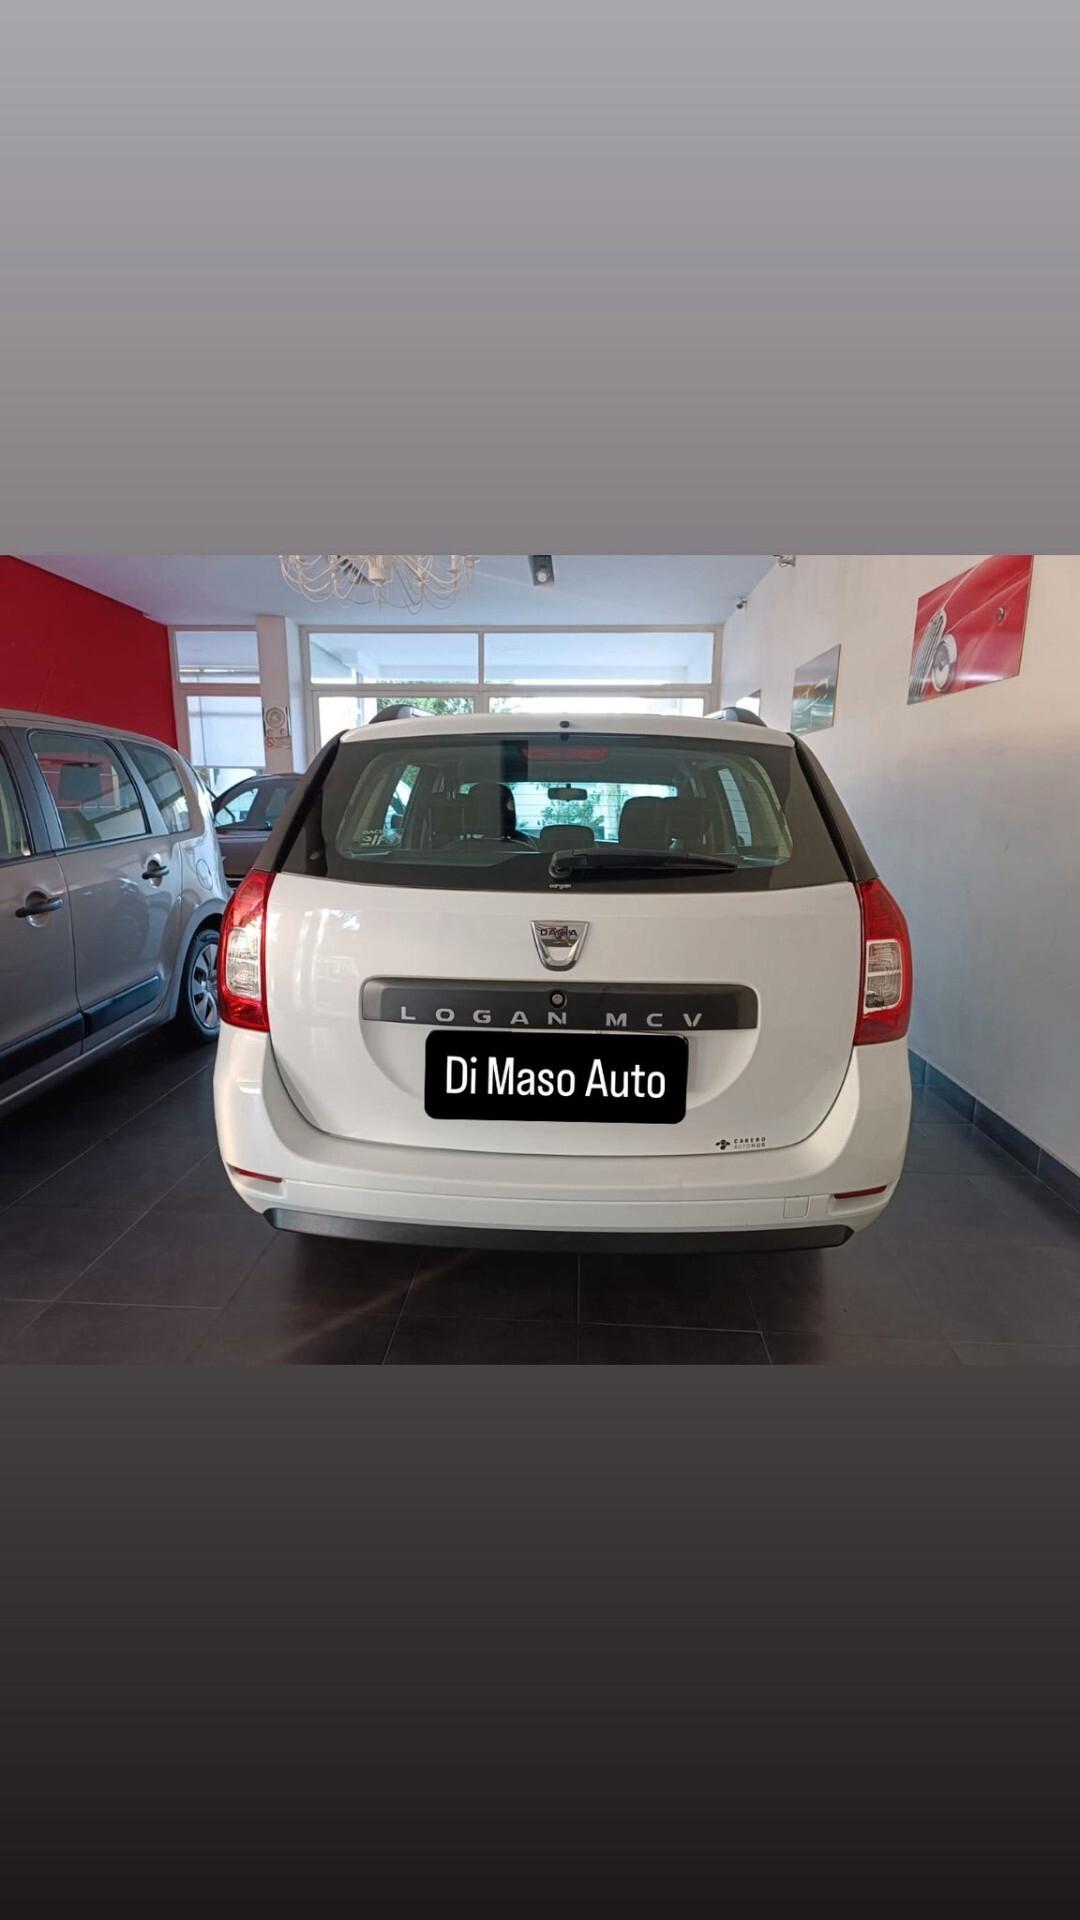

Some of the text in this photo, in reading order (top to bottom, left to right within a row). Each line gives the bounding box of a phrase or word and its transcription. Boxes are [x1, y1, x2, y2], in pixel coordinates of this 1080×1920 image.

[540, 928, 578, 937] DACIA
[400, 1006, 703, 1028] LOGAN MCV
